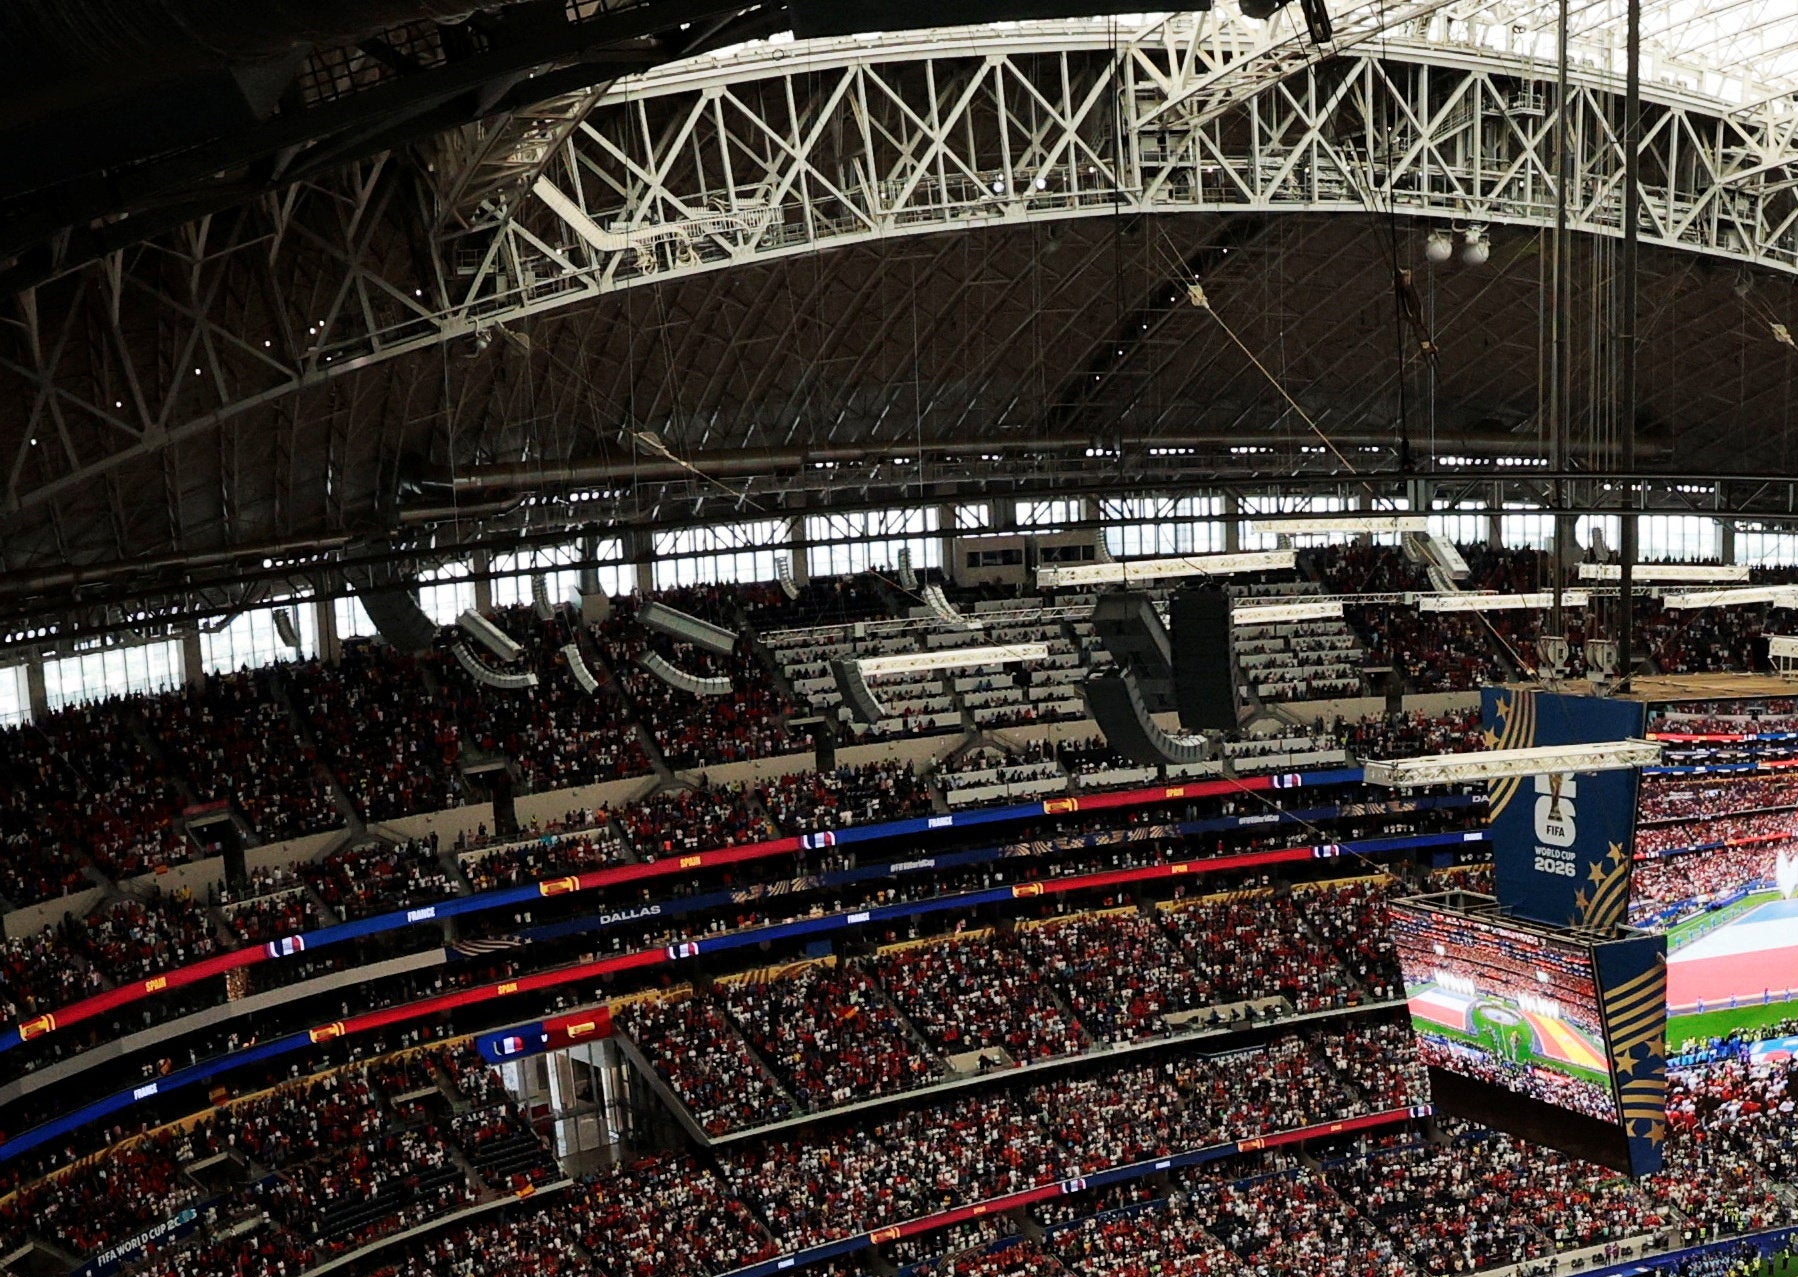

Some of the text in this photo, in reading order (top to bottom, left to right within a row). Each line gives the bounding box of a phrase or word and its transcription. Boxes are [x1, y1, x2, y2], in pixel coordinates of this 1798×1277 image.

[1546, 825, 1565, 837] FIFA
[1534, 845, 1576, 861] WORLD CUP
[680, 856, 701, 869] SPAIN
[1534, 857, 1576, 878] 2026
[407, 906, 436, 922] FRANCE
[600, 905, 662, 925] DALLAS
[145, 976, 167, 993] SPAIN
[497, 982, 518, 995] SPAIN
[133, 1082, 158, 1101] FRANCE
[97, 1250, 117, 1267] FIFA
[148, 1223, 167, 1241] CUP
